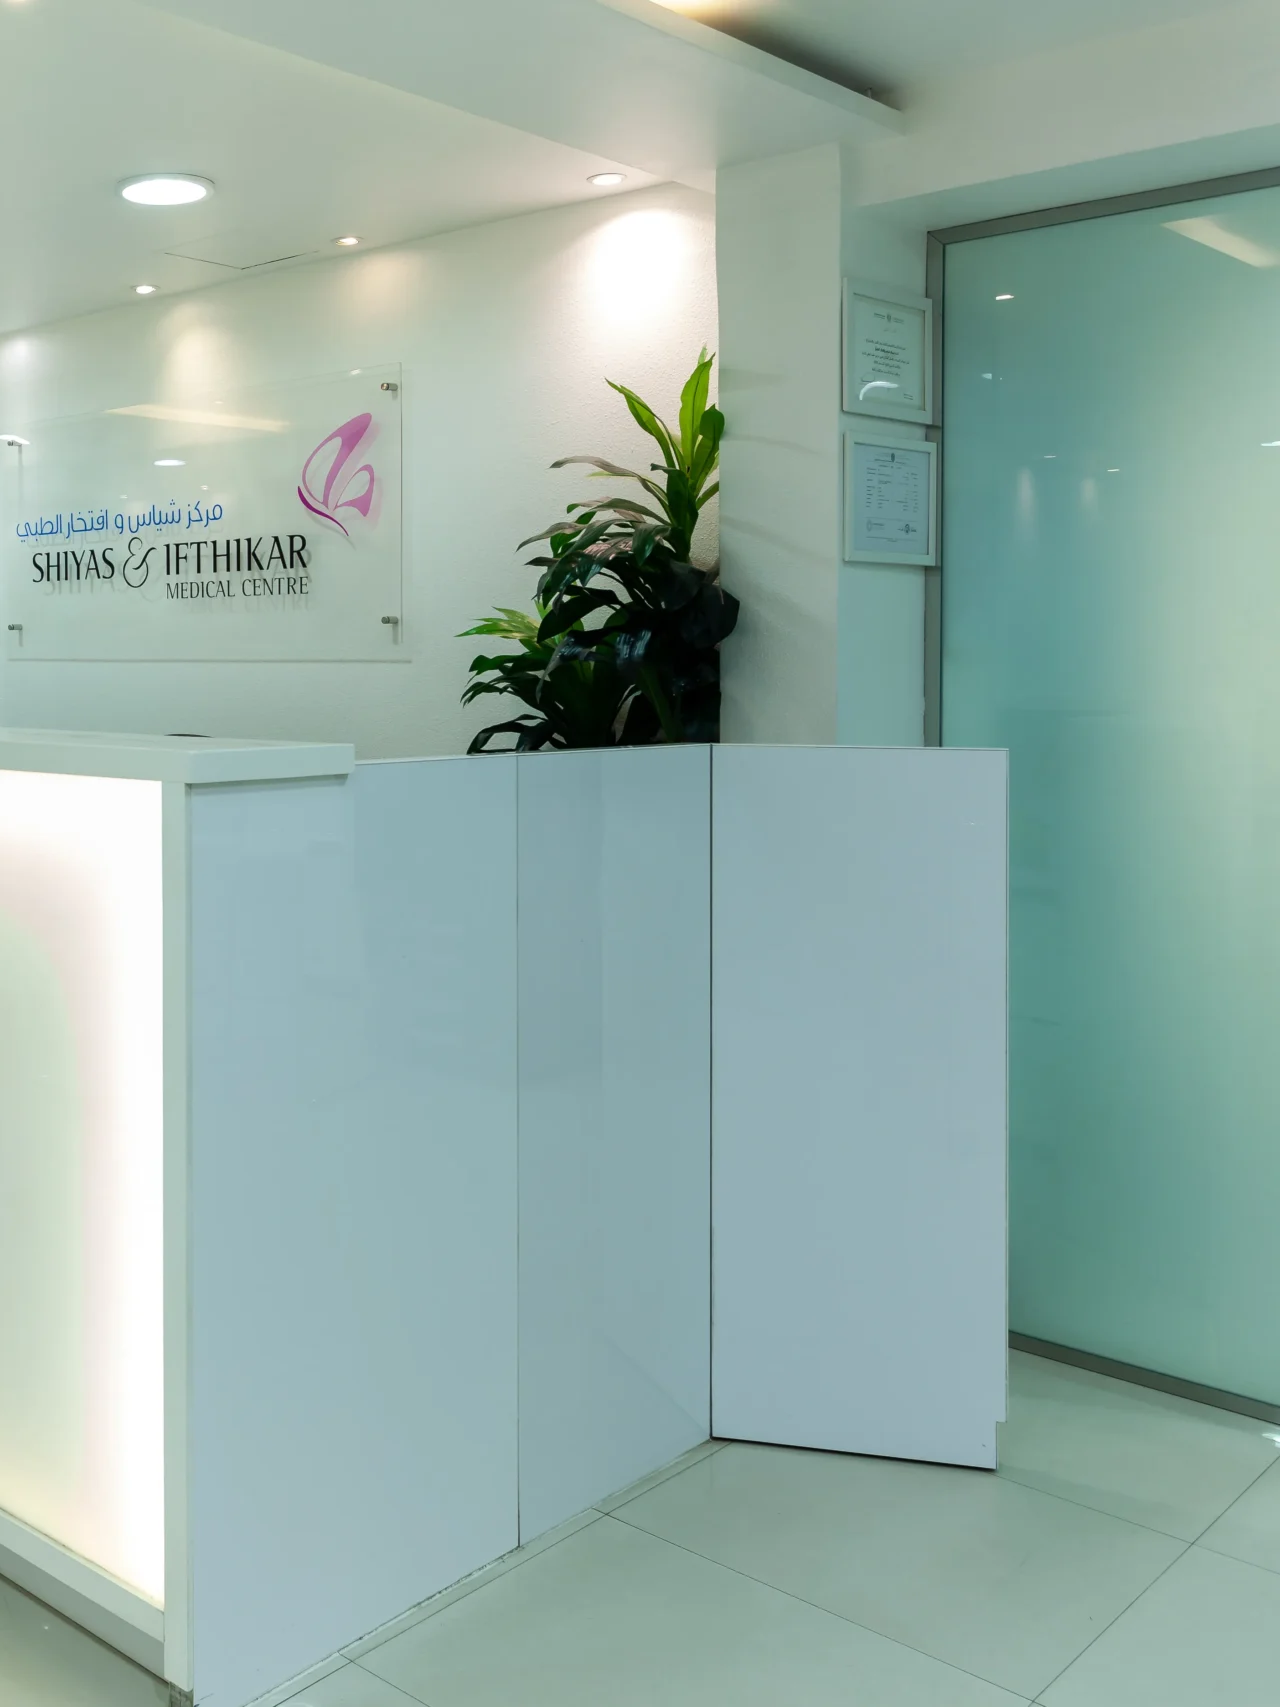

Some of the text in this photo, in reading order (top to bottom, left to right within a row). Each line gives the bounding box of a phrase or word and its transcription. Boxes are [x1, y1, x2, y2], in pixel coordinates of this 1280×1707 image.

[16, 498, 223, 543] مركز شياس و افتخار الطبي
[32, 534, 308, 589] SHIYAS & IFTHIKAR
[166, 576, 310, 600] MEDICAL CENTRE
